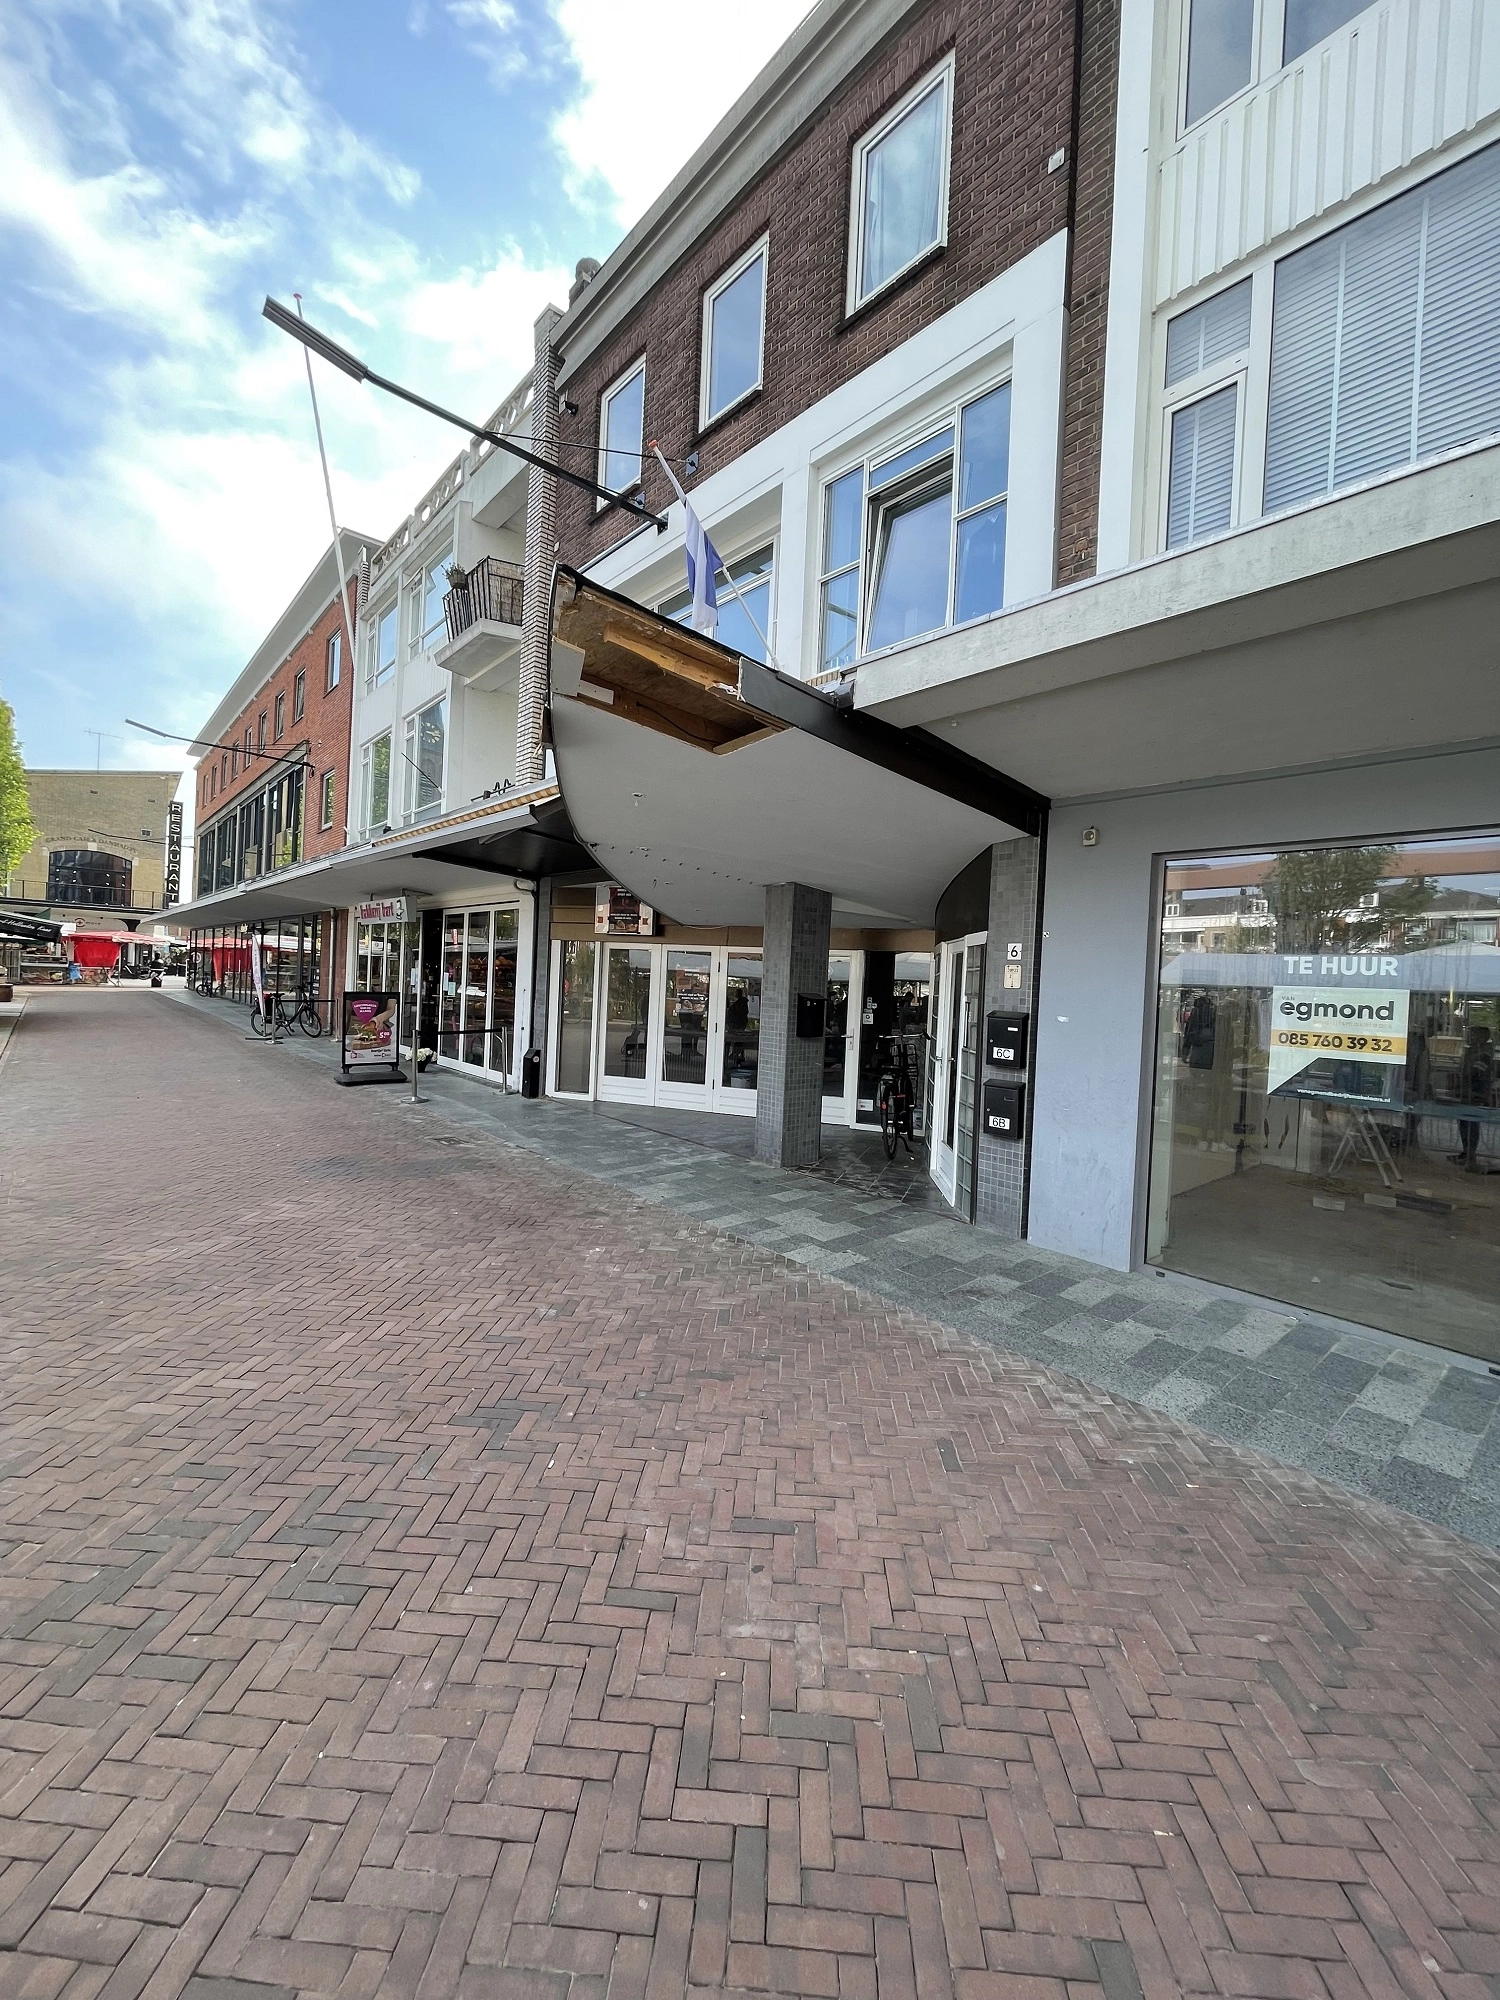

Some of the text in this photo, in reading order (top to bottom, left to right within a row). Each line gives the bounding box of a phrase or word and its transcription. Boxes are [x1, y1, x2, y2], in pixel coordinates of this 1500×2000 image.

[168, 803, 182, 901] RESTAURANT
[1010, 945, 1019, 958] 6
[1283, 956, 1399, 977] TE HUUR
[1279, 1001, 1395, 1022] egmond
[1278, 1032, 1393, 1052] 085 760 39 32
[996, 1048, 1011, 1059] 6C
[992, 1117, 1006, 1128] 6B
